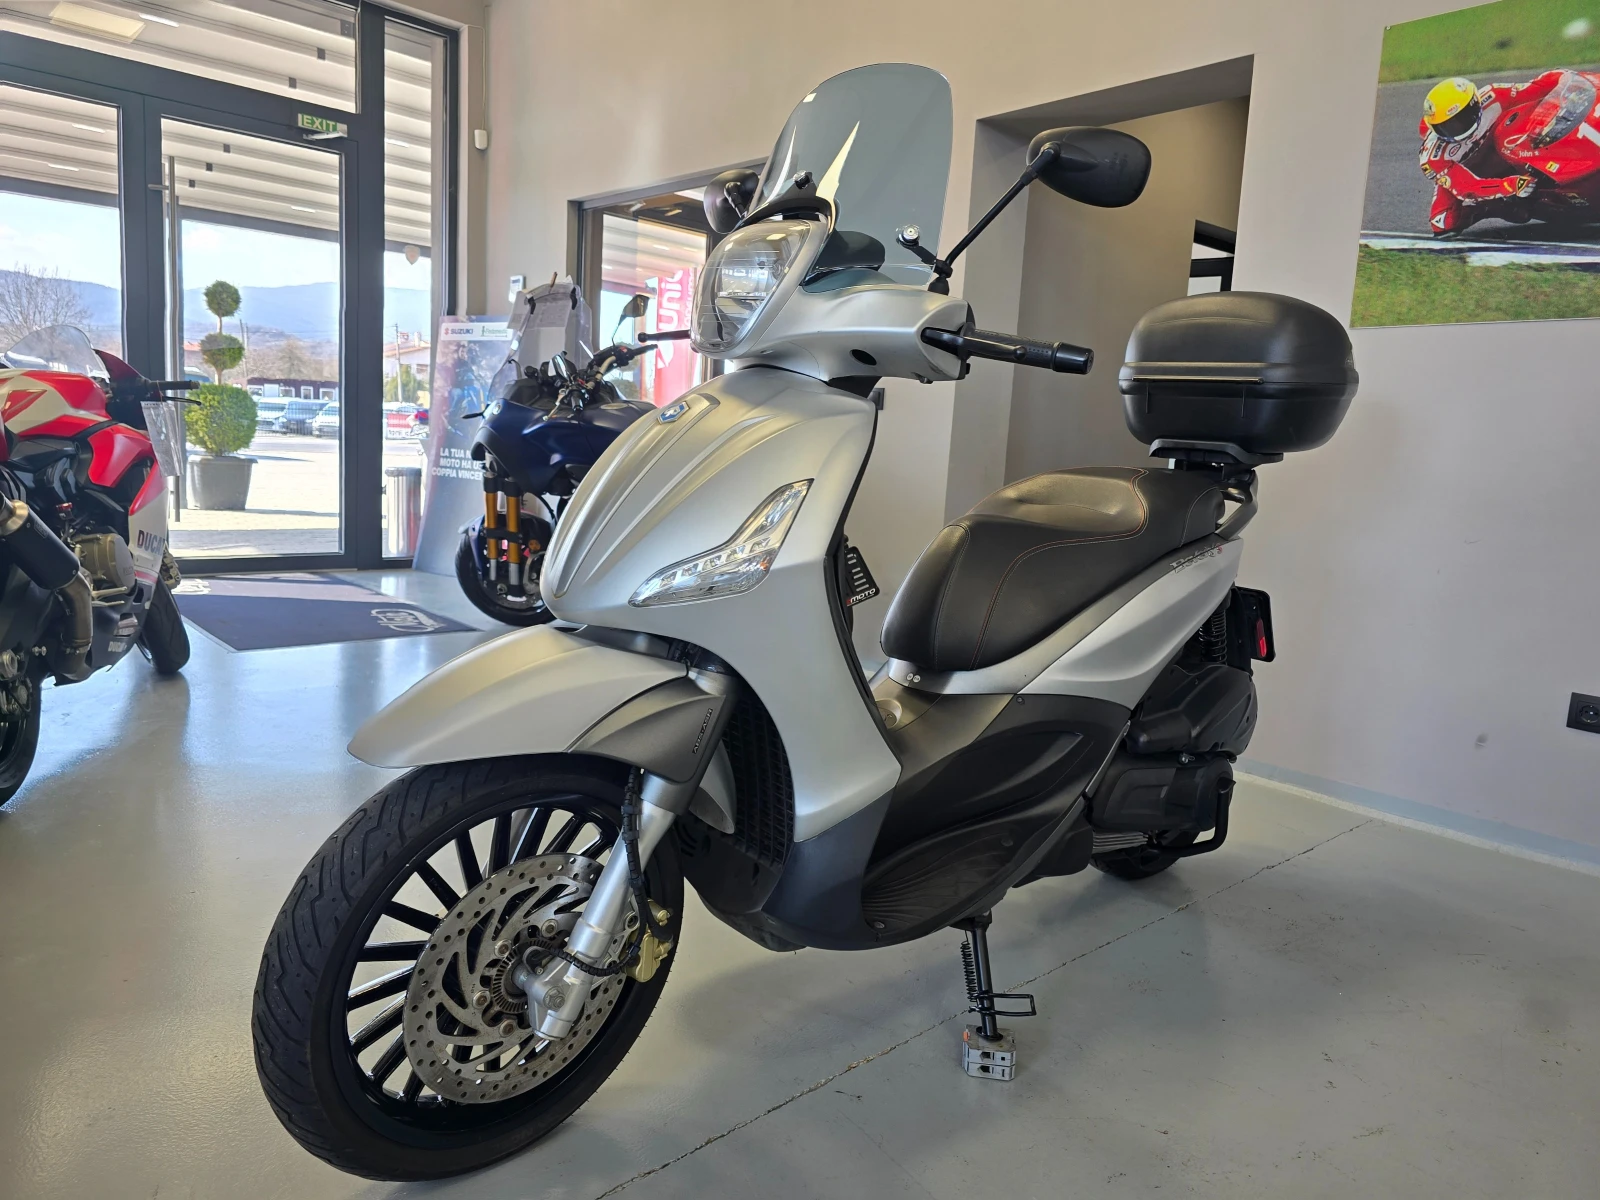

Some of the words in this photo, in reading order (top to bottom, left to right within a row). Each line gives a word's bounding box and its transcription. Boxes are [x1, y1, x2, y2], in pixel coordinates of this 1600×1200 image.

[303, 114, 335, 132] EXIT
[440, 448, 449, 457] LA
[450, 449, 465, 458] TUA
[440, 458, 460, 468] MOTO
[461, 460, 472, 469] HA
[431, 467, 457, 478] COPPIA
[137, 529, 165, 556] DUCA
